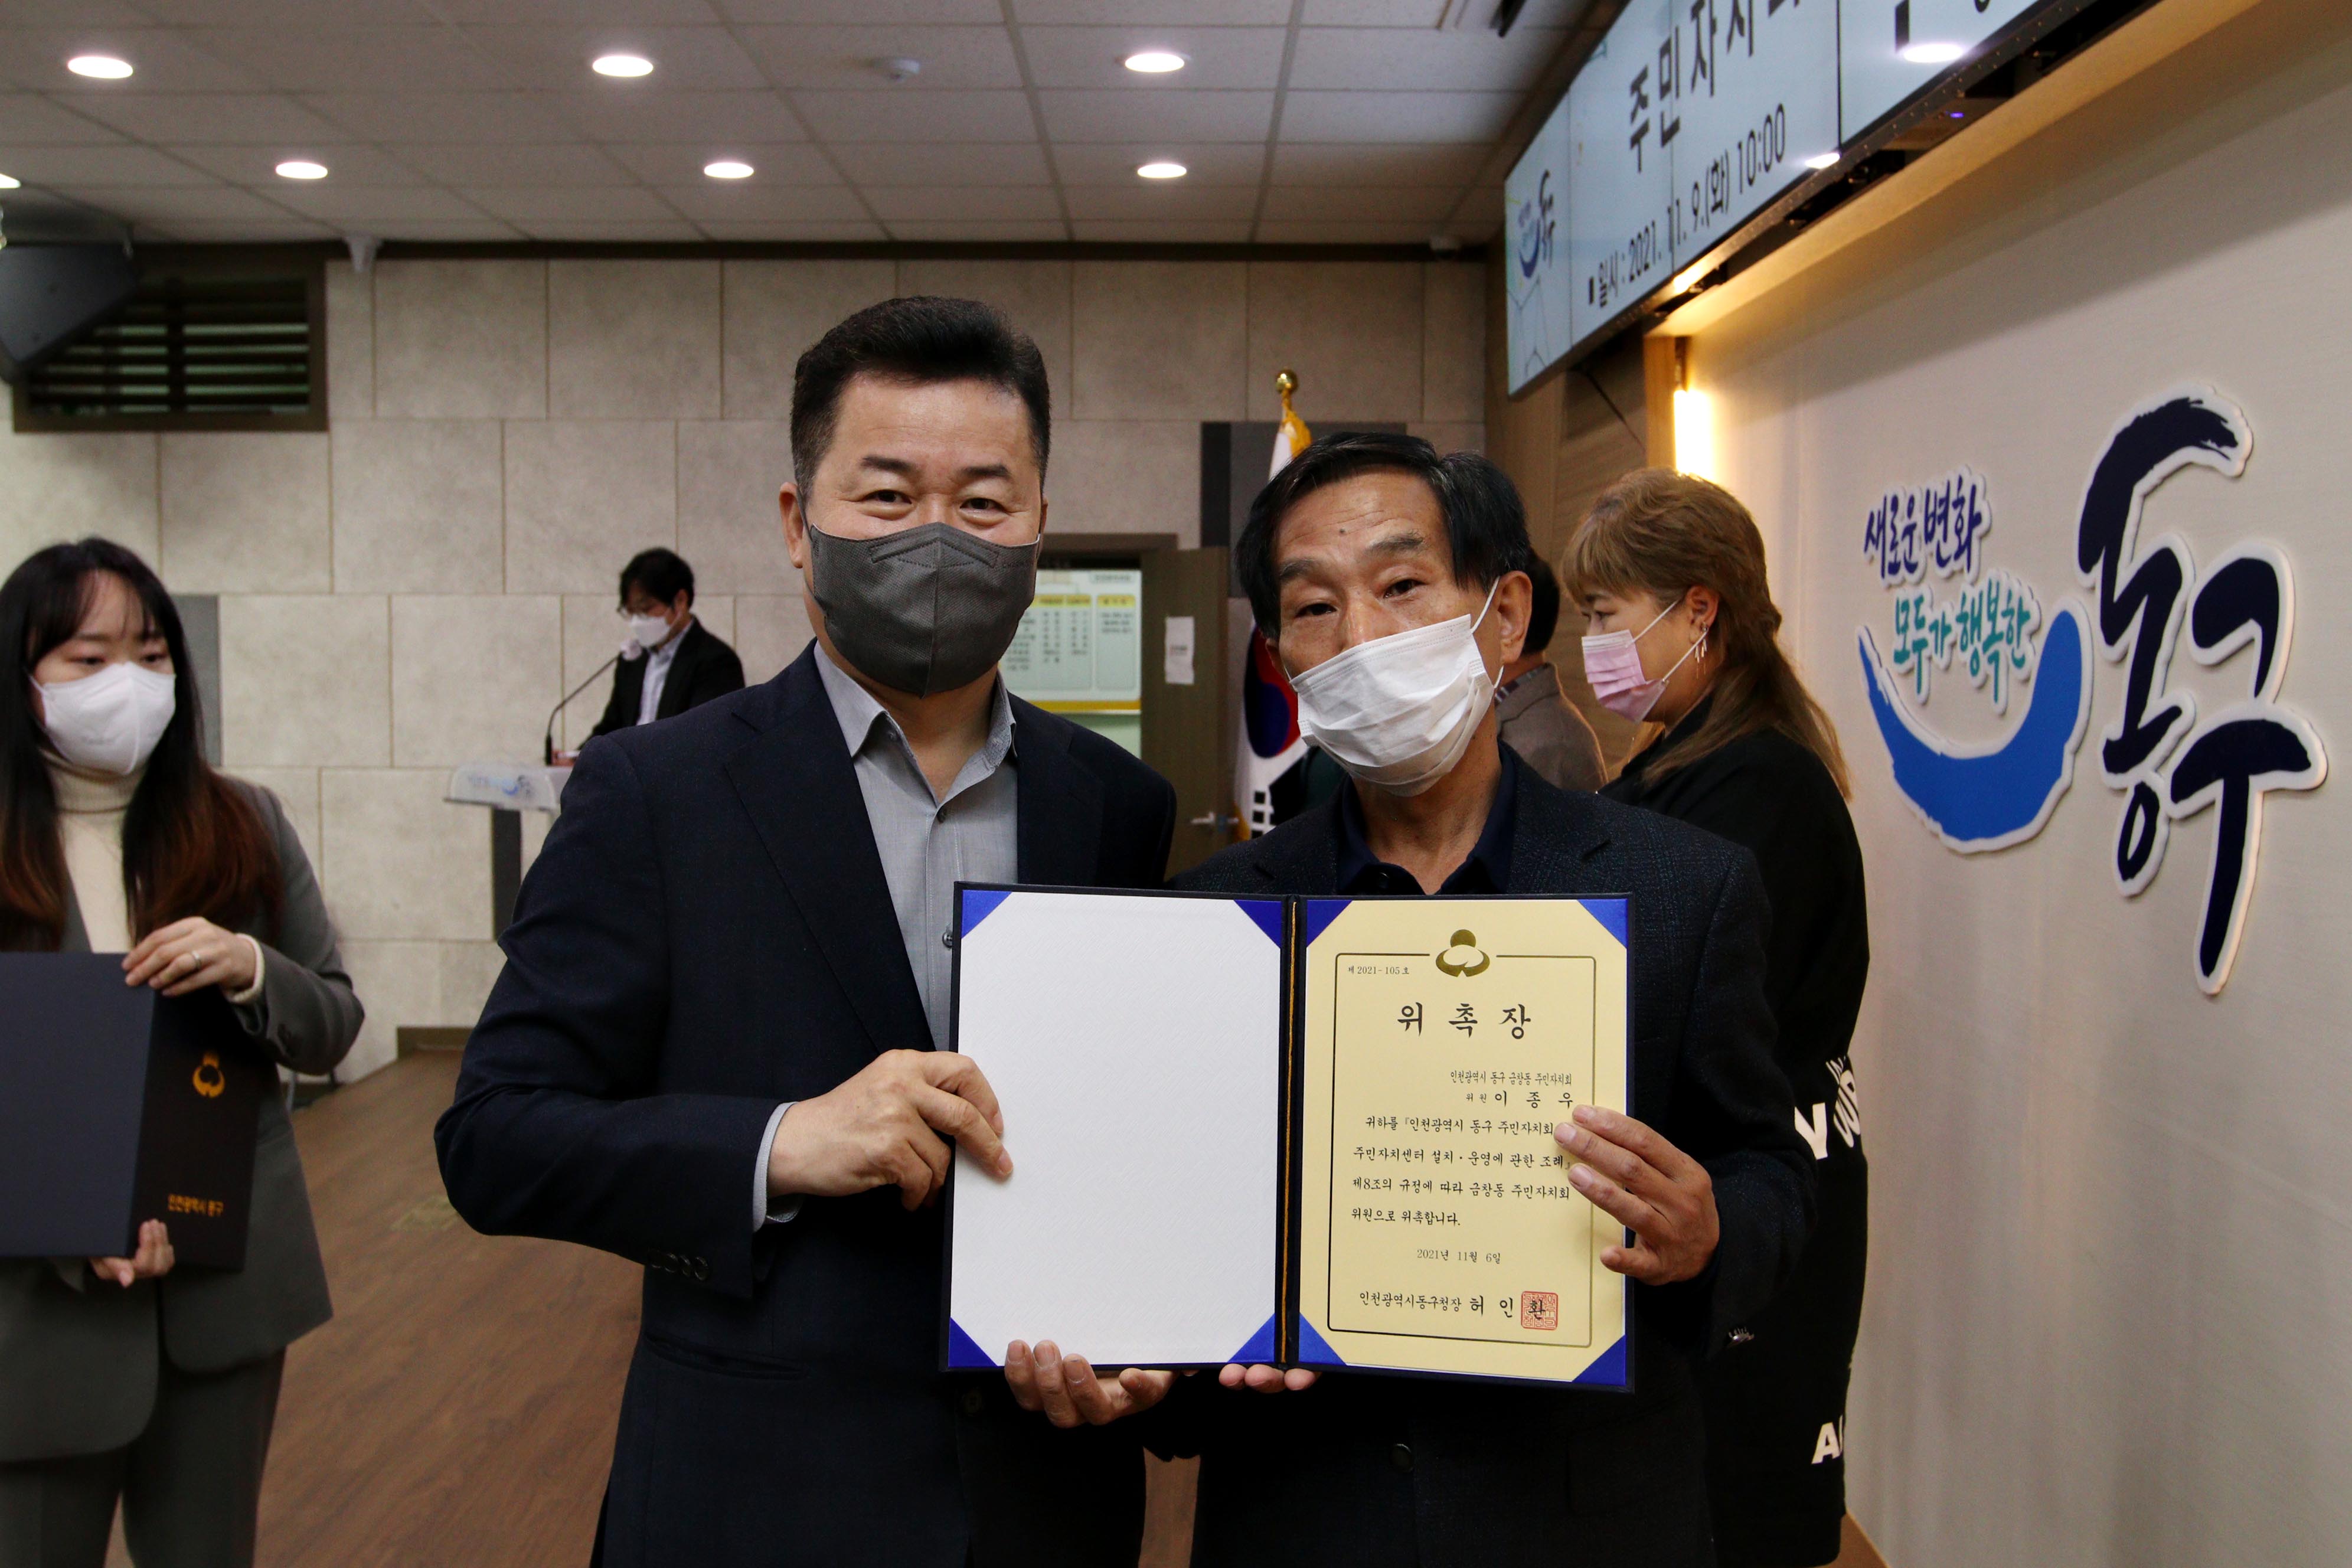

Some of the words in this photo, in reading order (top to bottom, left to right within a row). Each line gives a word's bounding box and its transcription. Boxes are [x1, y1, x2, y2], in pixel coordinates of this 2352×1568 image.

[1737, 103, 1785, 195] 10:00
[1864, 494, 1919, 579] 새로운
[1922, 475, 1983, 574] 변화
[1894, 593, 1952, 695] 모두가
[1955, 577, 2031, 703] 행복한
[1450, 1070, 1486, 1084] 인천광역시
[1490, 1072, 1506, 1085] 동구
[1508, 1072, 1532, 1086] 금창동
[1534, 1073, 1572, 1086] 주민자치회
[1365, 1115, 1399, 1131] 귀하를
[1469, 1119, 1492, 1134] 동구
[1497, 1121, 1553, 1136] 주민자치회
[1353, 1146, 1424, 1163] 주민자치센터
[1509, 1153, 1535, 1168] 관한
[1353, 1176, 1392, 1191] 제8조의
[1399, 1178, 1432, 1194] 규정에
[1440, 1180, 1464, 1195] 따라
[1469, 1182, 1505, 1198] 금창동
[1511, 1184, 1570, 1200] 주민자치회
[1351, 1207, 1396, 1223] 위원으로
[1401, 1210, 1461, 1227] 위촉합니다.
[1416, 1248, 1449, 1262] 2021년
[1458, 1251, 1478, 1263] 11월
[1485, 1252, 1501, 1265] 6일
[1360, 1291, 1462, 1312] 인천광역시동구청장
